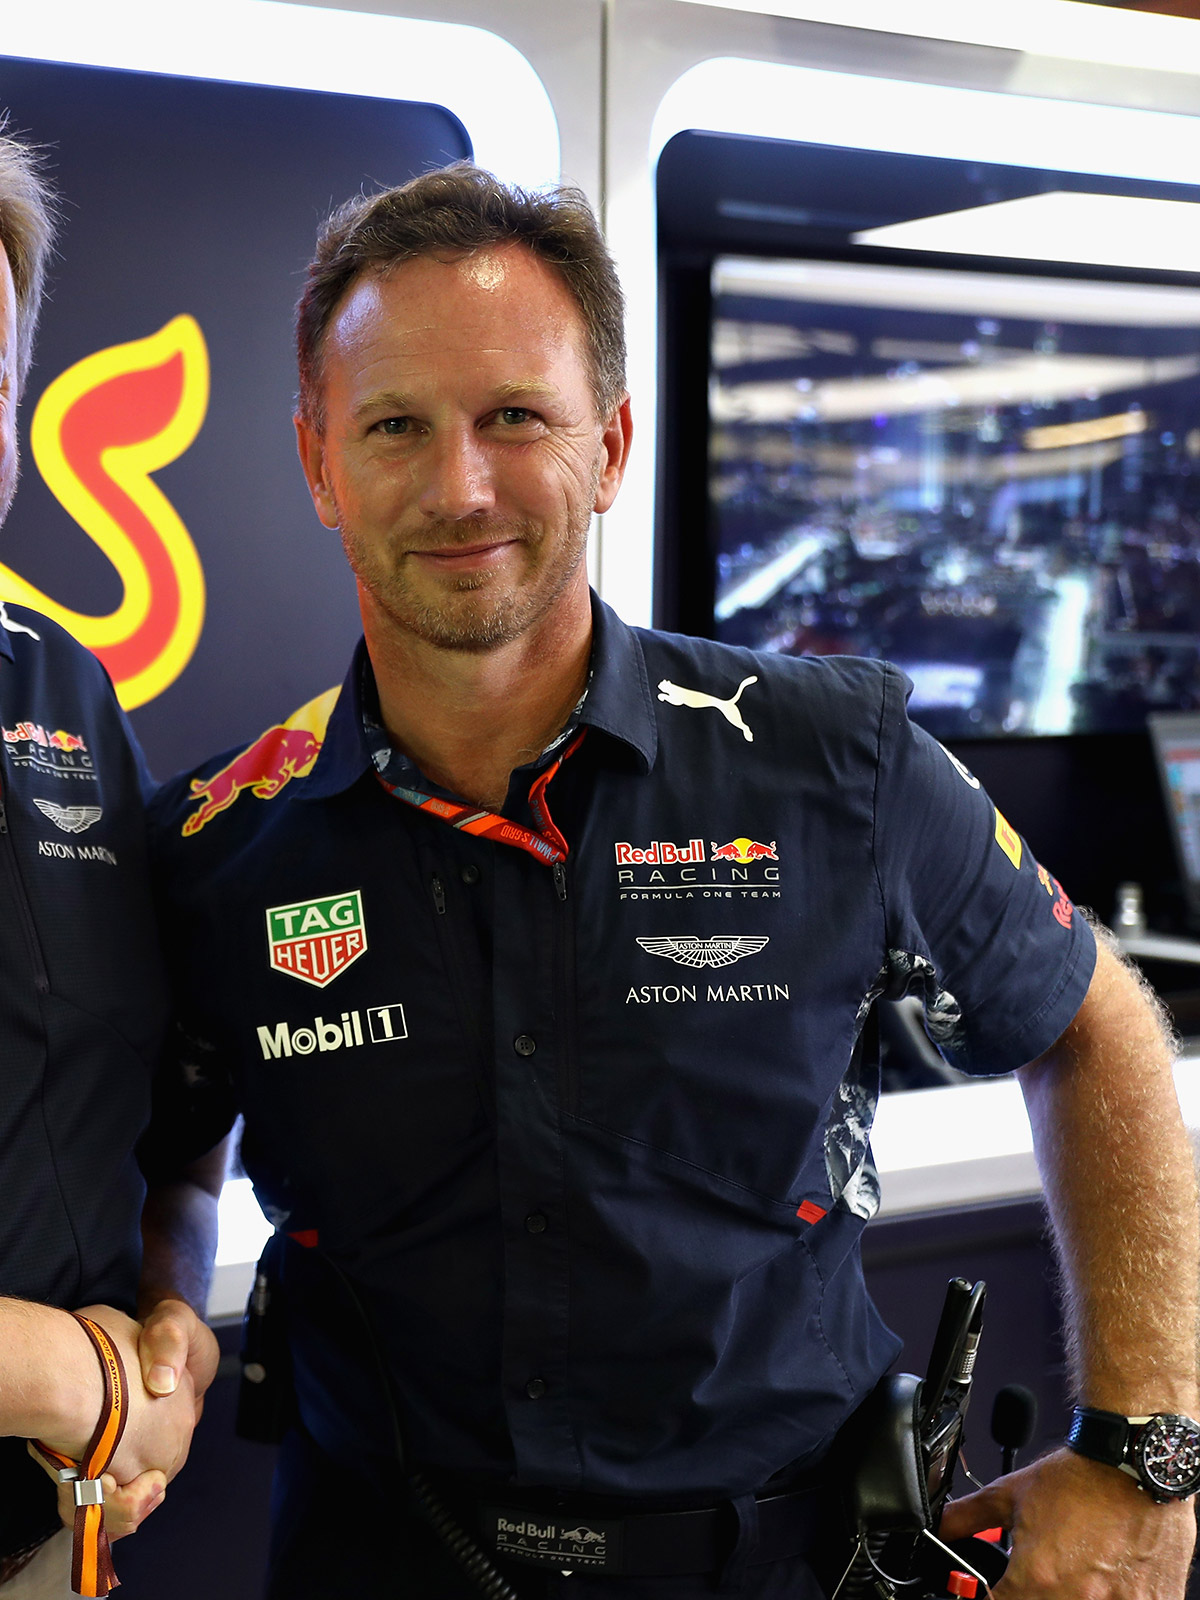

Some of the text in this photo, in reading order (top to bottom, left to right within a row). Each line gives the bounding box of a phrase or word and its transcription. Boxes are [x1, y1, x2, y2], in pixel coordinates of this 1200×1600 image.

[1, 721, 31, 743] ed
[5, 744, 93, 768] RACING
[38, 840, 117, 866] ASTON MARN
[614, 839, 706, 866] Red Bull
[618, 867, 780, 883] RACING
[620, 891, 694, 900] FORMULA
[274, 900, 355, 937] TAG
[276, 932, 361, 981] HEUER
[678, 942, 703, 950] ASTON
[625, 984, 790, 1004] ASTON MARTIN
[256, 1010, 364, 1060] Mobil
[497, 1518, 556, 1539] Red Bull
[496, 1534, 606, 1556] RACING
